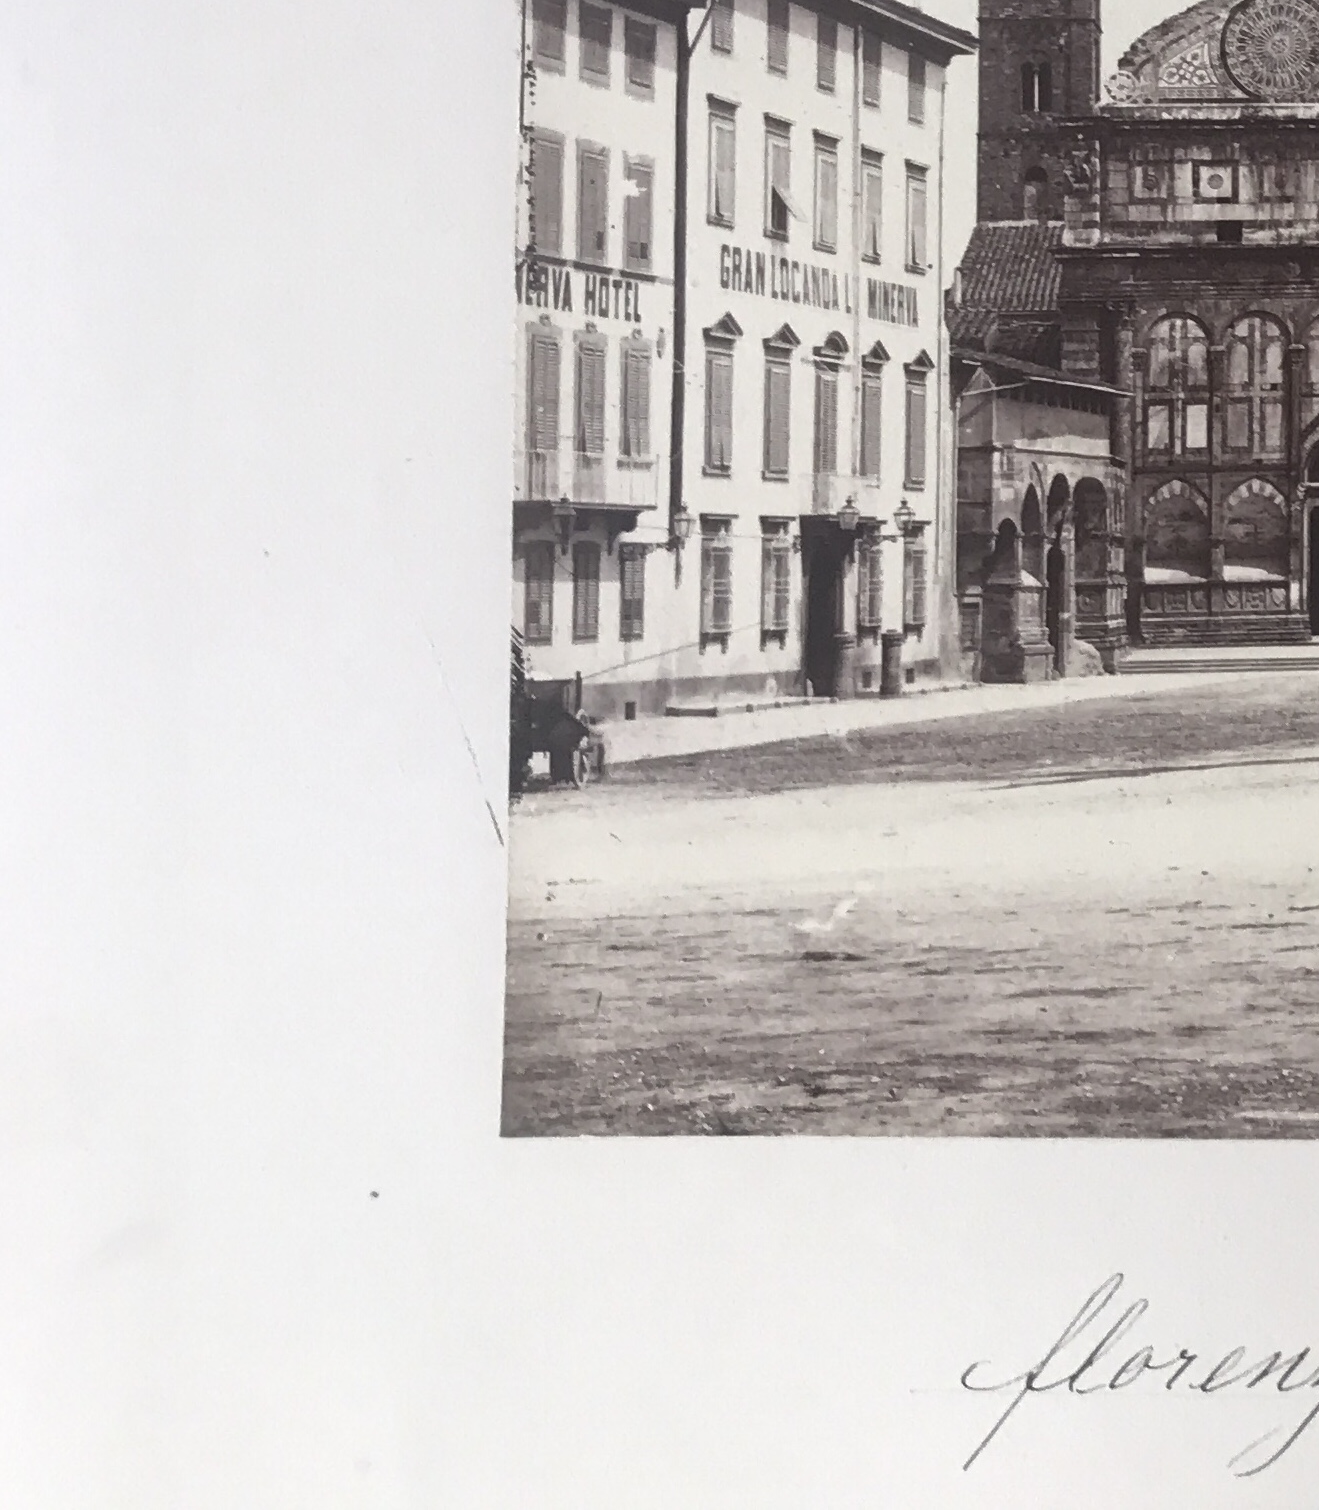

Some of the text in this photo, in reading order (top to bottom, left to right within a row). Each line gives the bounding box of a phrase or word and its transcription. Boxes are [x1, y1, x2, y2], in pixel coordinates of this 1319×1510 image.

[585, 273, 642, 323] HOTEL
[720, 243, 766, 297] GRAN
[770, 254, 840, 311] LOCANDA
